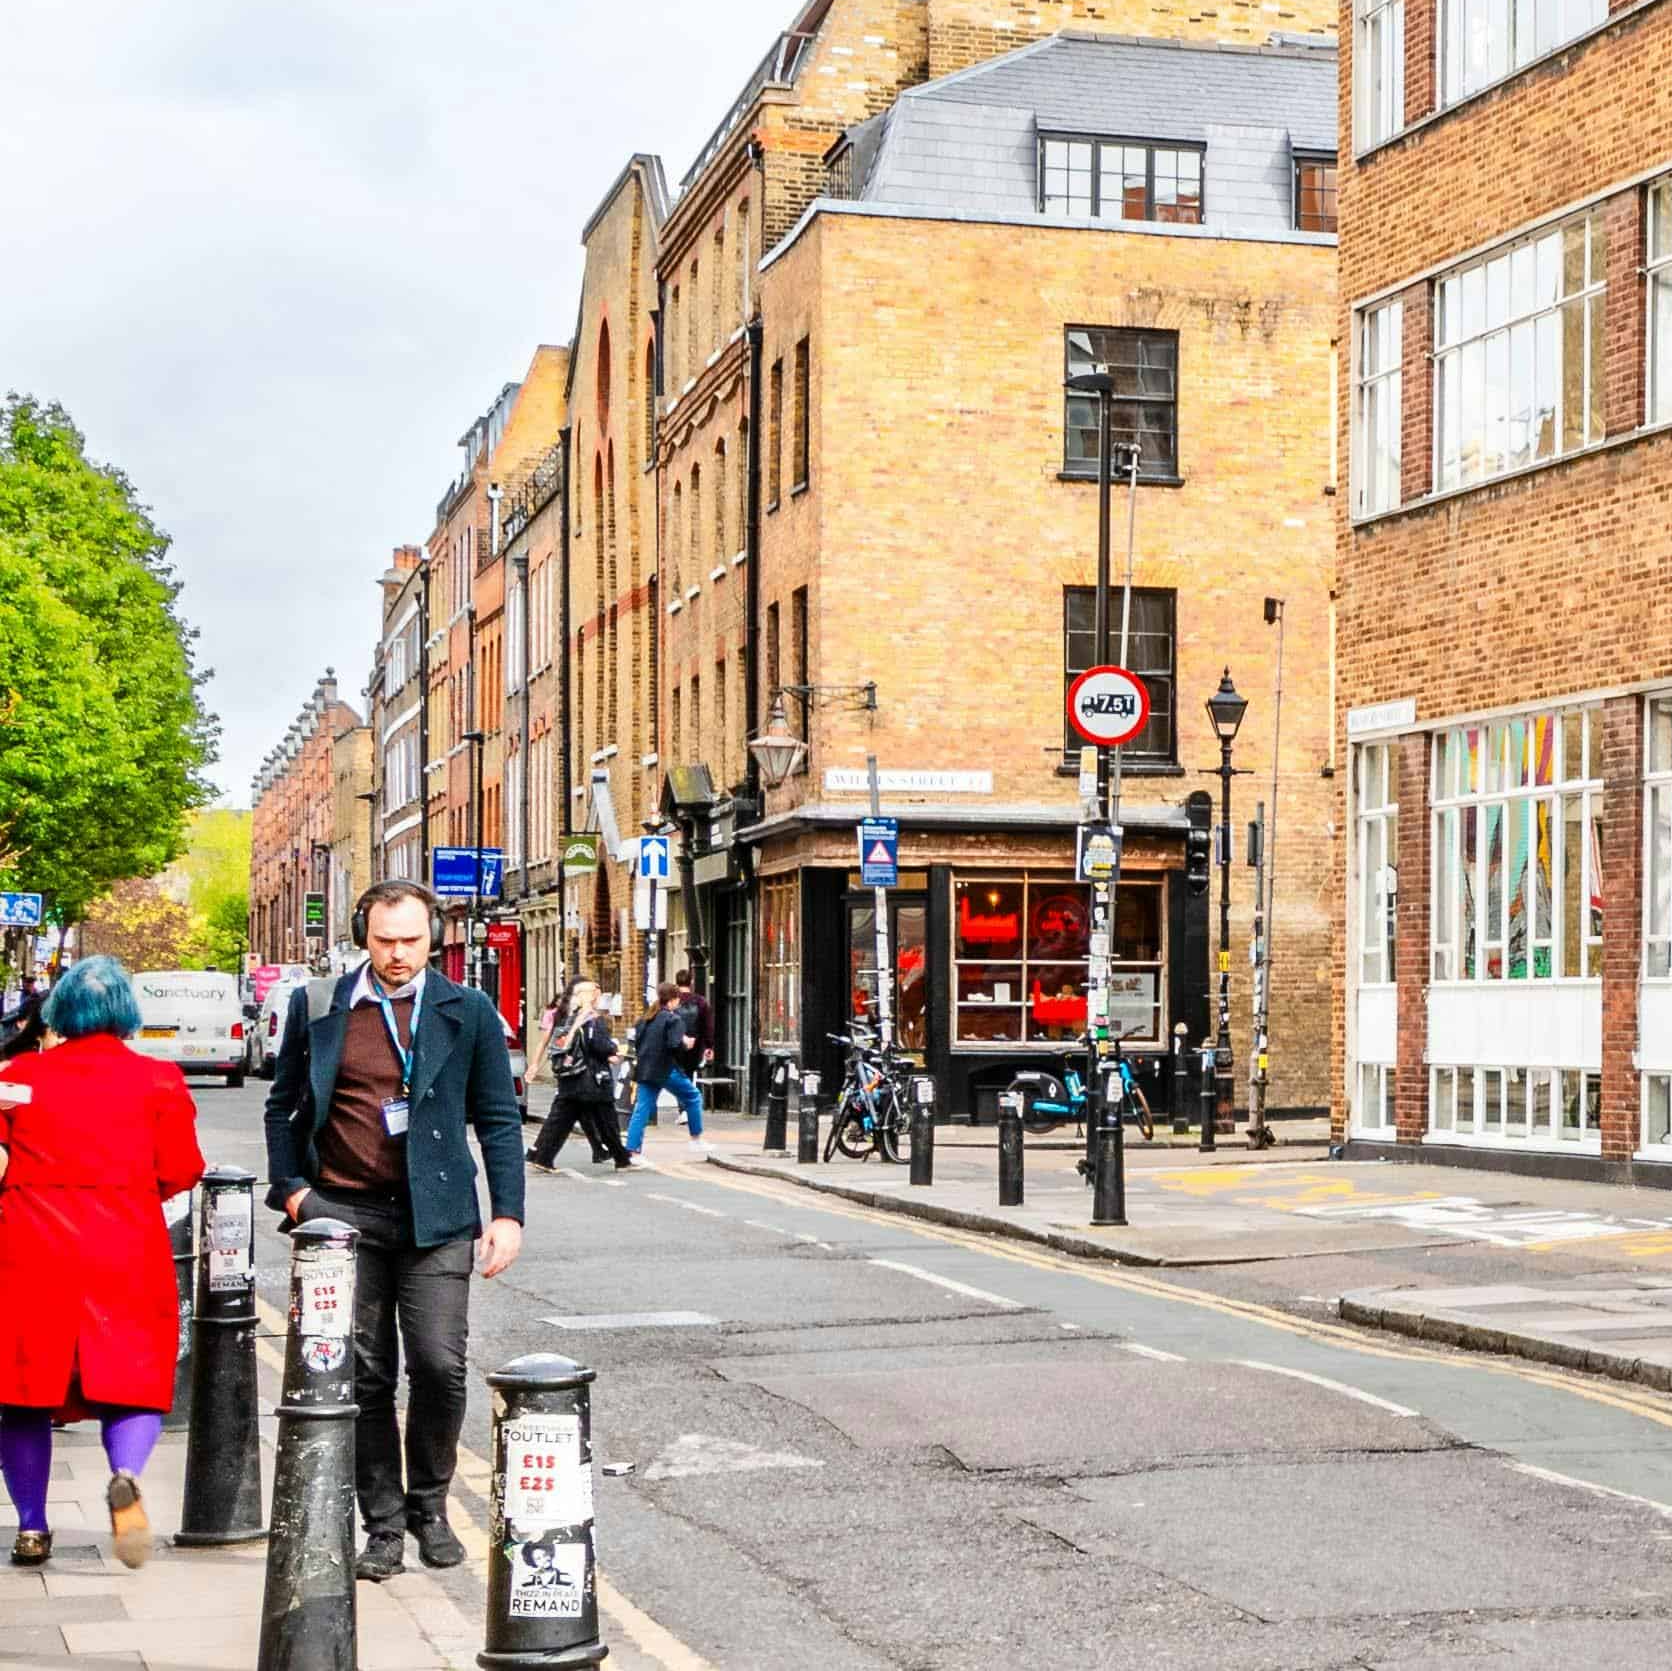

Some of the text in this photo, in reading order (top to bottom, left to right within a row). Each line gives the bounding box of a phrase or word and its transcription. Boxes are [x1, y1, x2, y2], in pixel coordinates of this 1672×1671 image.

[143, 984, 225, 1000] Sanctuary
[314, 1286, 336, 1297] £15
[314, 1300, 338, 1311] £25
[510, 1431, 573, 1443] OUTLET
[523, 1454, 556, 1469] £15
[519, 1476, 555, 1491] £25
[512, 1599, 580, 1613] REMAND
